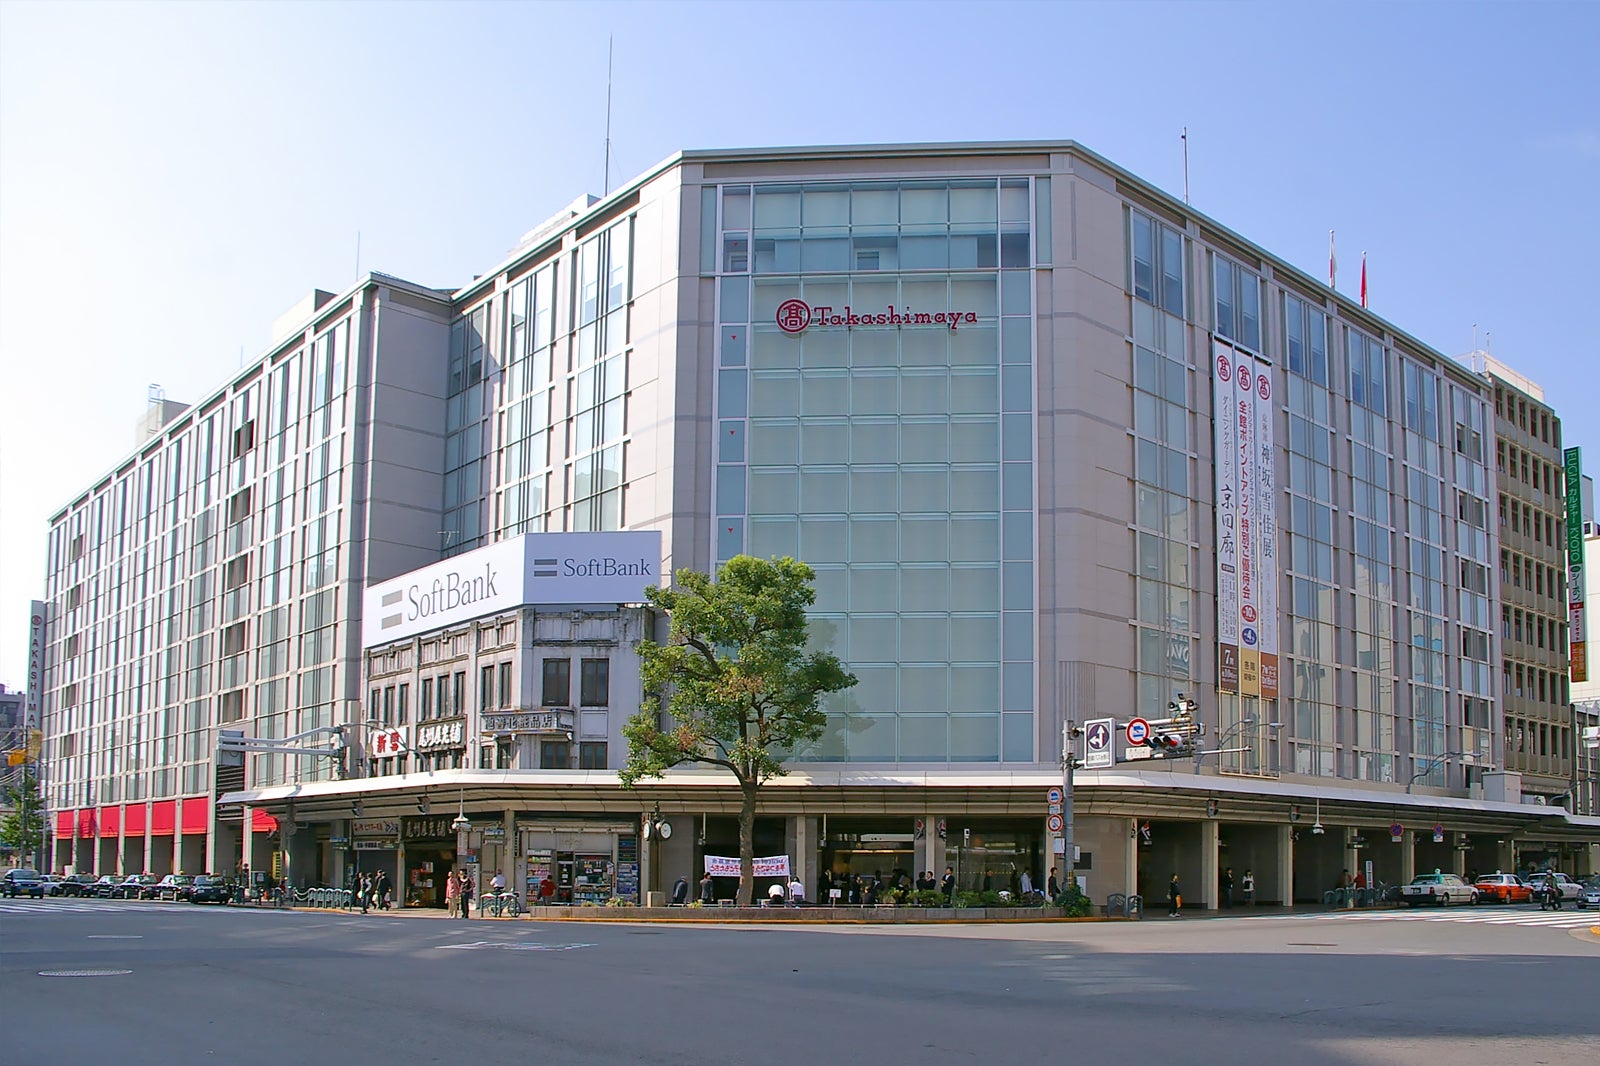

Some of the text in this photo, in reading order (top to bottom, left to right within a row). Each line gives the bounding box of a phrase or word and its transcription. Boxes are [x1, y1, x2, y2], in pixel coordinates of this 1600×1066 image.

[814, 305, 978, 329] Takashimaya
[1569, 528, 1580, 562] KYOTO
[564, 557, 651, 577] SoftBank
[408, 562, 499, 622] SoftBank
[28, 627, 40, 728] TAKASHIMA
